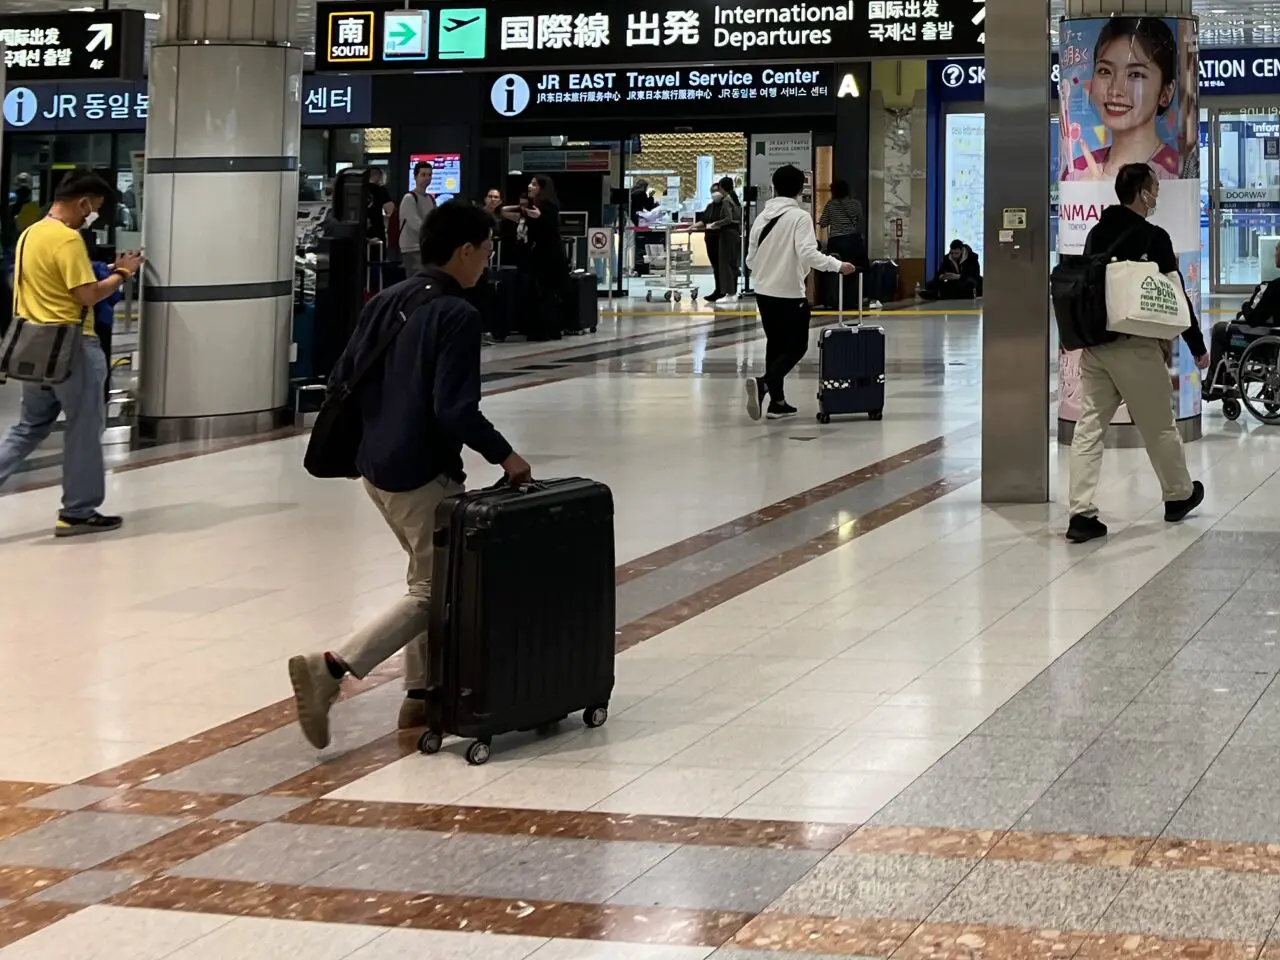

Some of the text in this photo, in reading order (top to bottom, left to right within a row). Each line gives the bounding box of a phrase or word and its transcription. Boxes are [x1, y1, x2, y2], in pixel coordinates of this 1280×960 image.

[714, 0, 854, 25] International
[868, 0, 940, 20] 国际出发
[338, 17, 365, 44] 南
[500, 9, 700, 50] 国際線 出発
[713, 26, 832, 50] Departures
[868, 20, 955, 42] 국제선 출발
[976, 31, 986, 44] 4
[331, 45, 369, 57] SOUTH
[537, 69, 820, 90] JR EAST Travel Service Center
[837, 74, 860, 98] A
[42, 94, 77, 119] JR
[304, 86, 352, 113] 센터
[1226, 191, 1267, 199] DOORWAY
